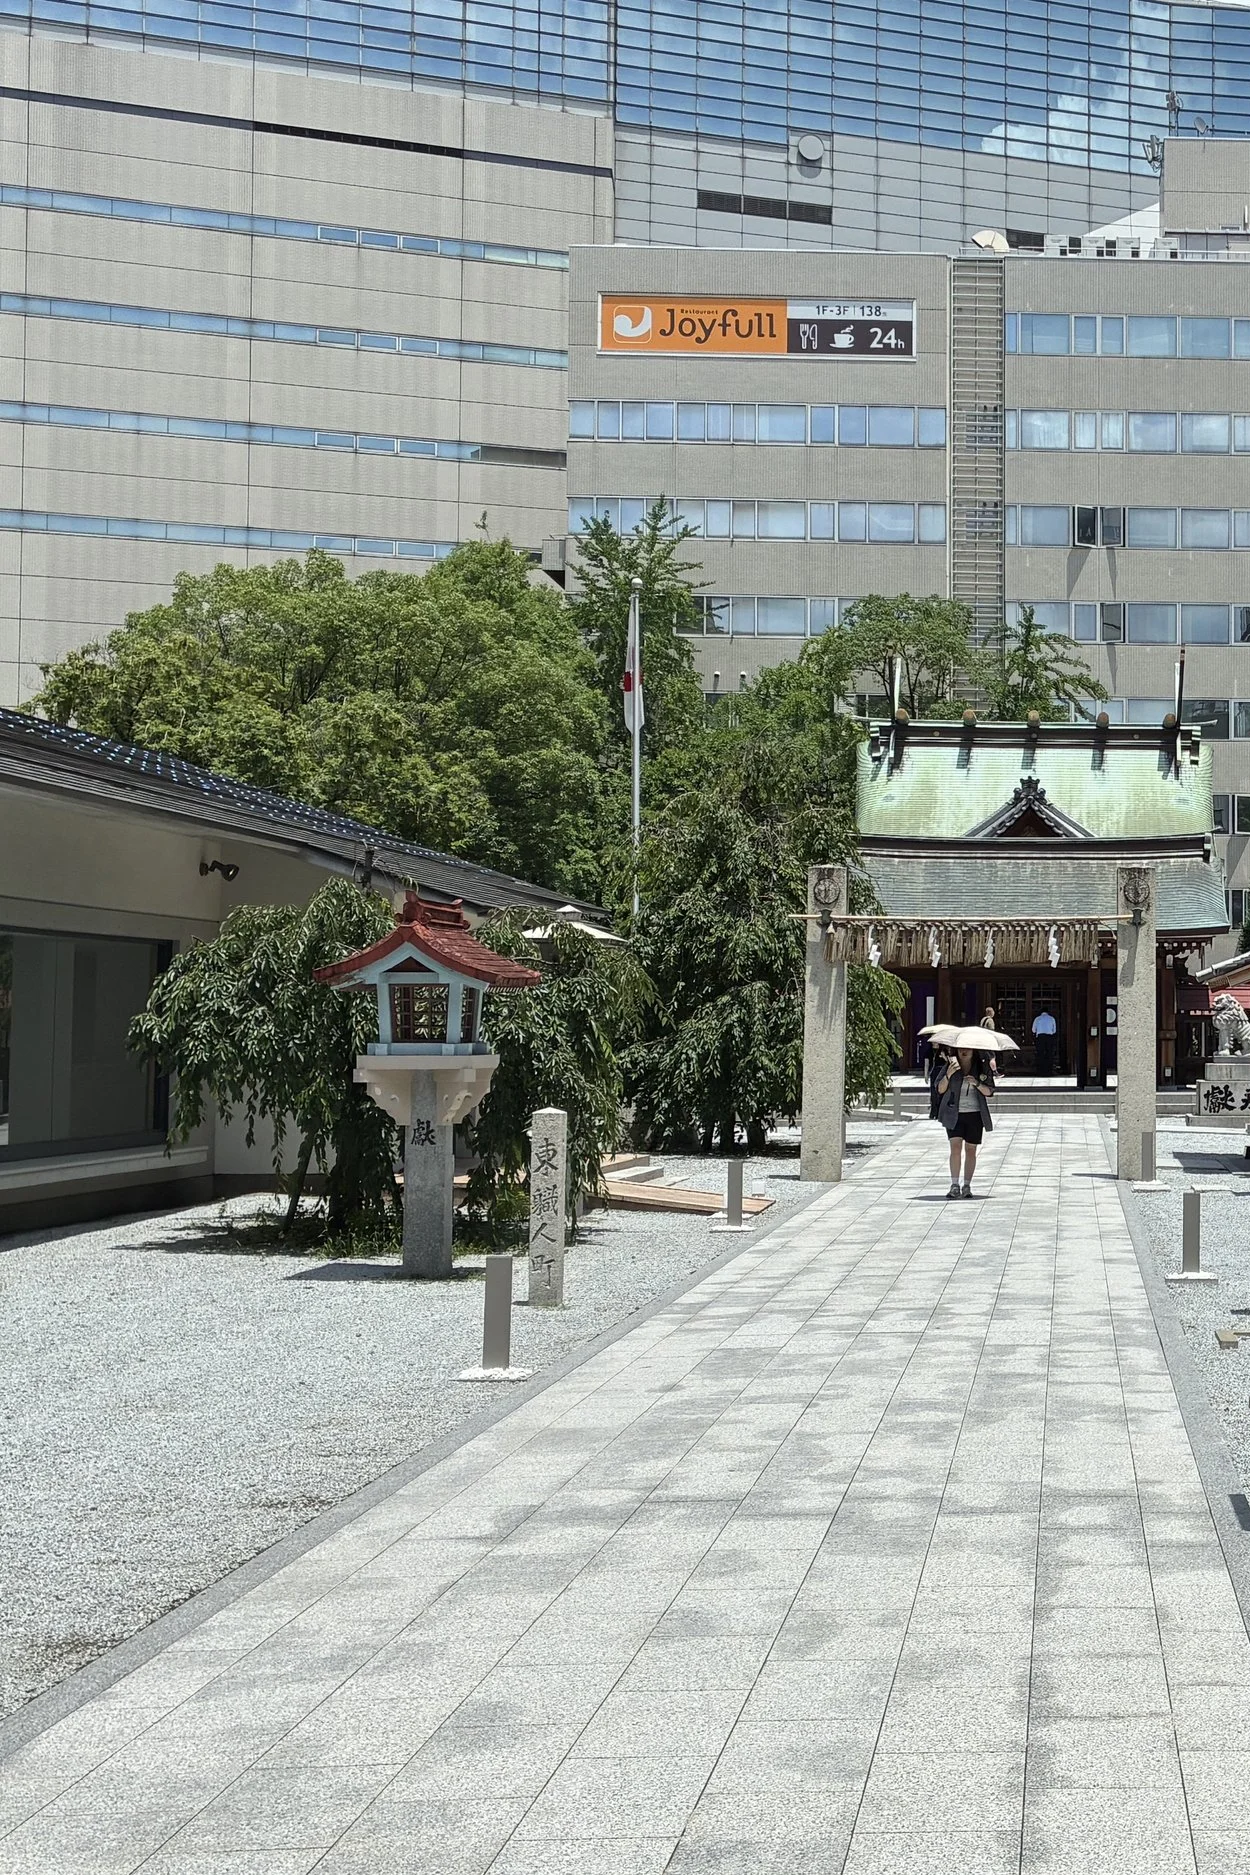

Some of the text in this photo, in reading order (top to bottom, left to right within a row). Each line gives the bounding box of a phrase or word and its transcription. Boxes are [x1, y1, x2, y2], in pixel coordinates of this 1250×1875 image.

[816, 305, 850, 317] 1F-3F
[659, 303, 777, 344] Joyfull
[869, 327, 905, 349] 24h
